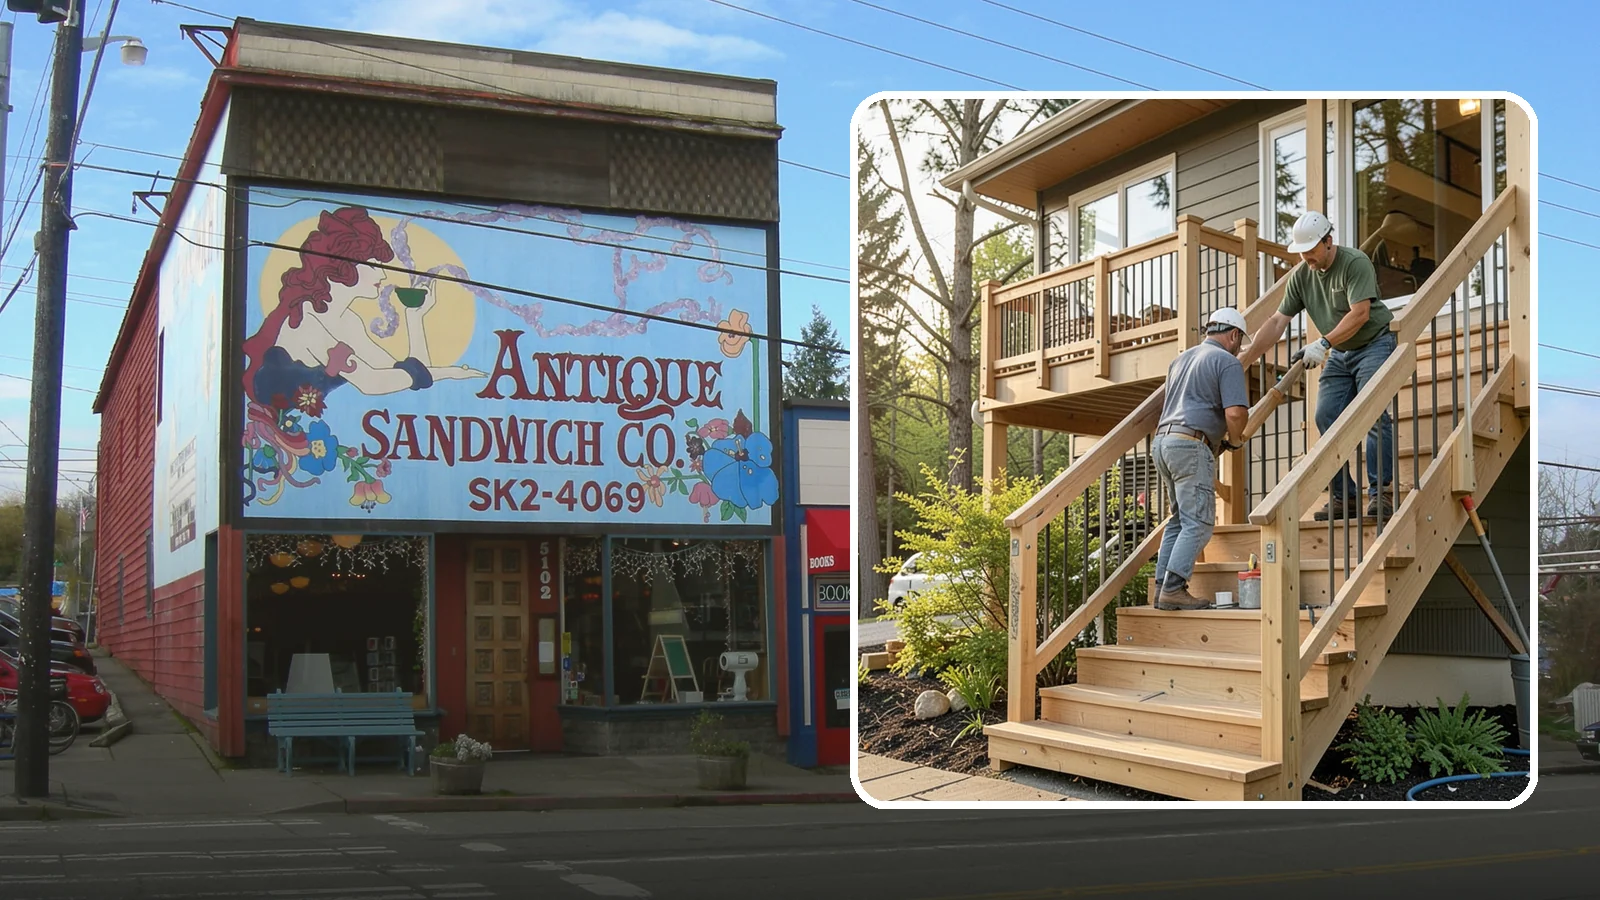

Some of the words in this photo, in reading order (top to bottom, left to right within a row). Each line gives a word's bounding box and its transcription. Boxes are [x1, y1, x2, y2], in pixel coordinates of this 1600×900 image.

[476, 329, 723, 421] ANTIQUE
[361, 408, 605, 466] SANDWICH
[616, 421, 685, 469] CO.
[468, 477, 646, 513] SK2-4069
[540, 541, 551, 599] 5102
[809, 555, 835, 569] BOOKS
